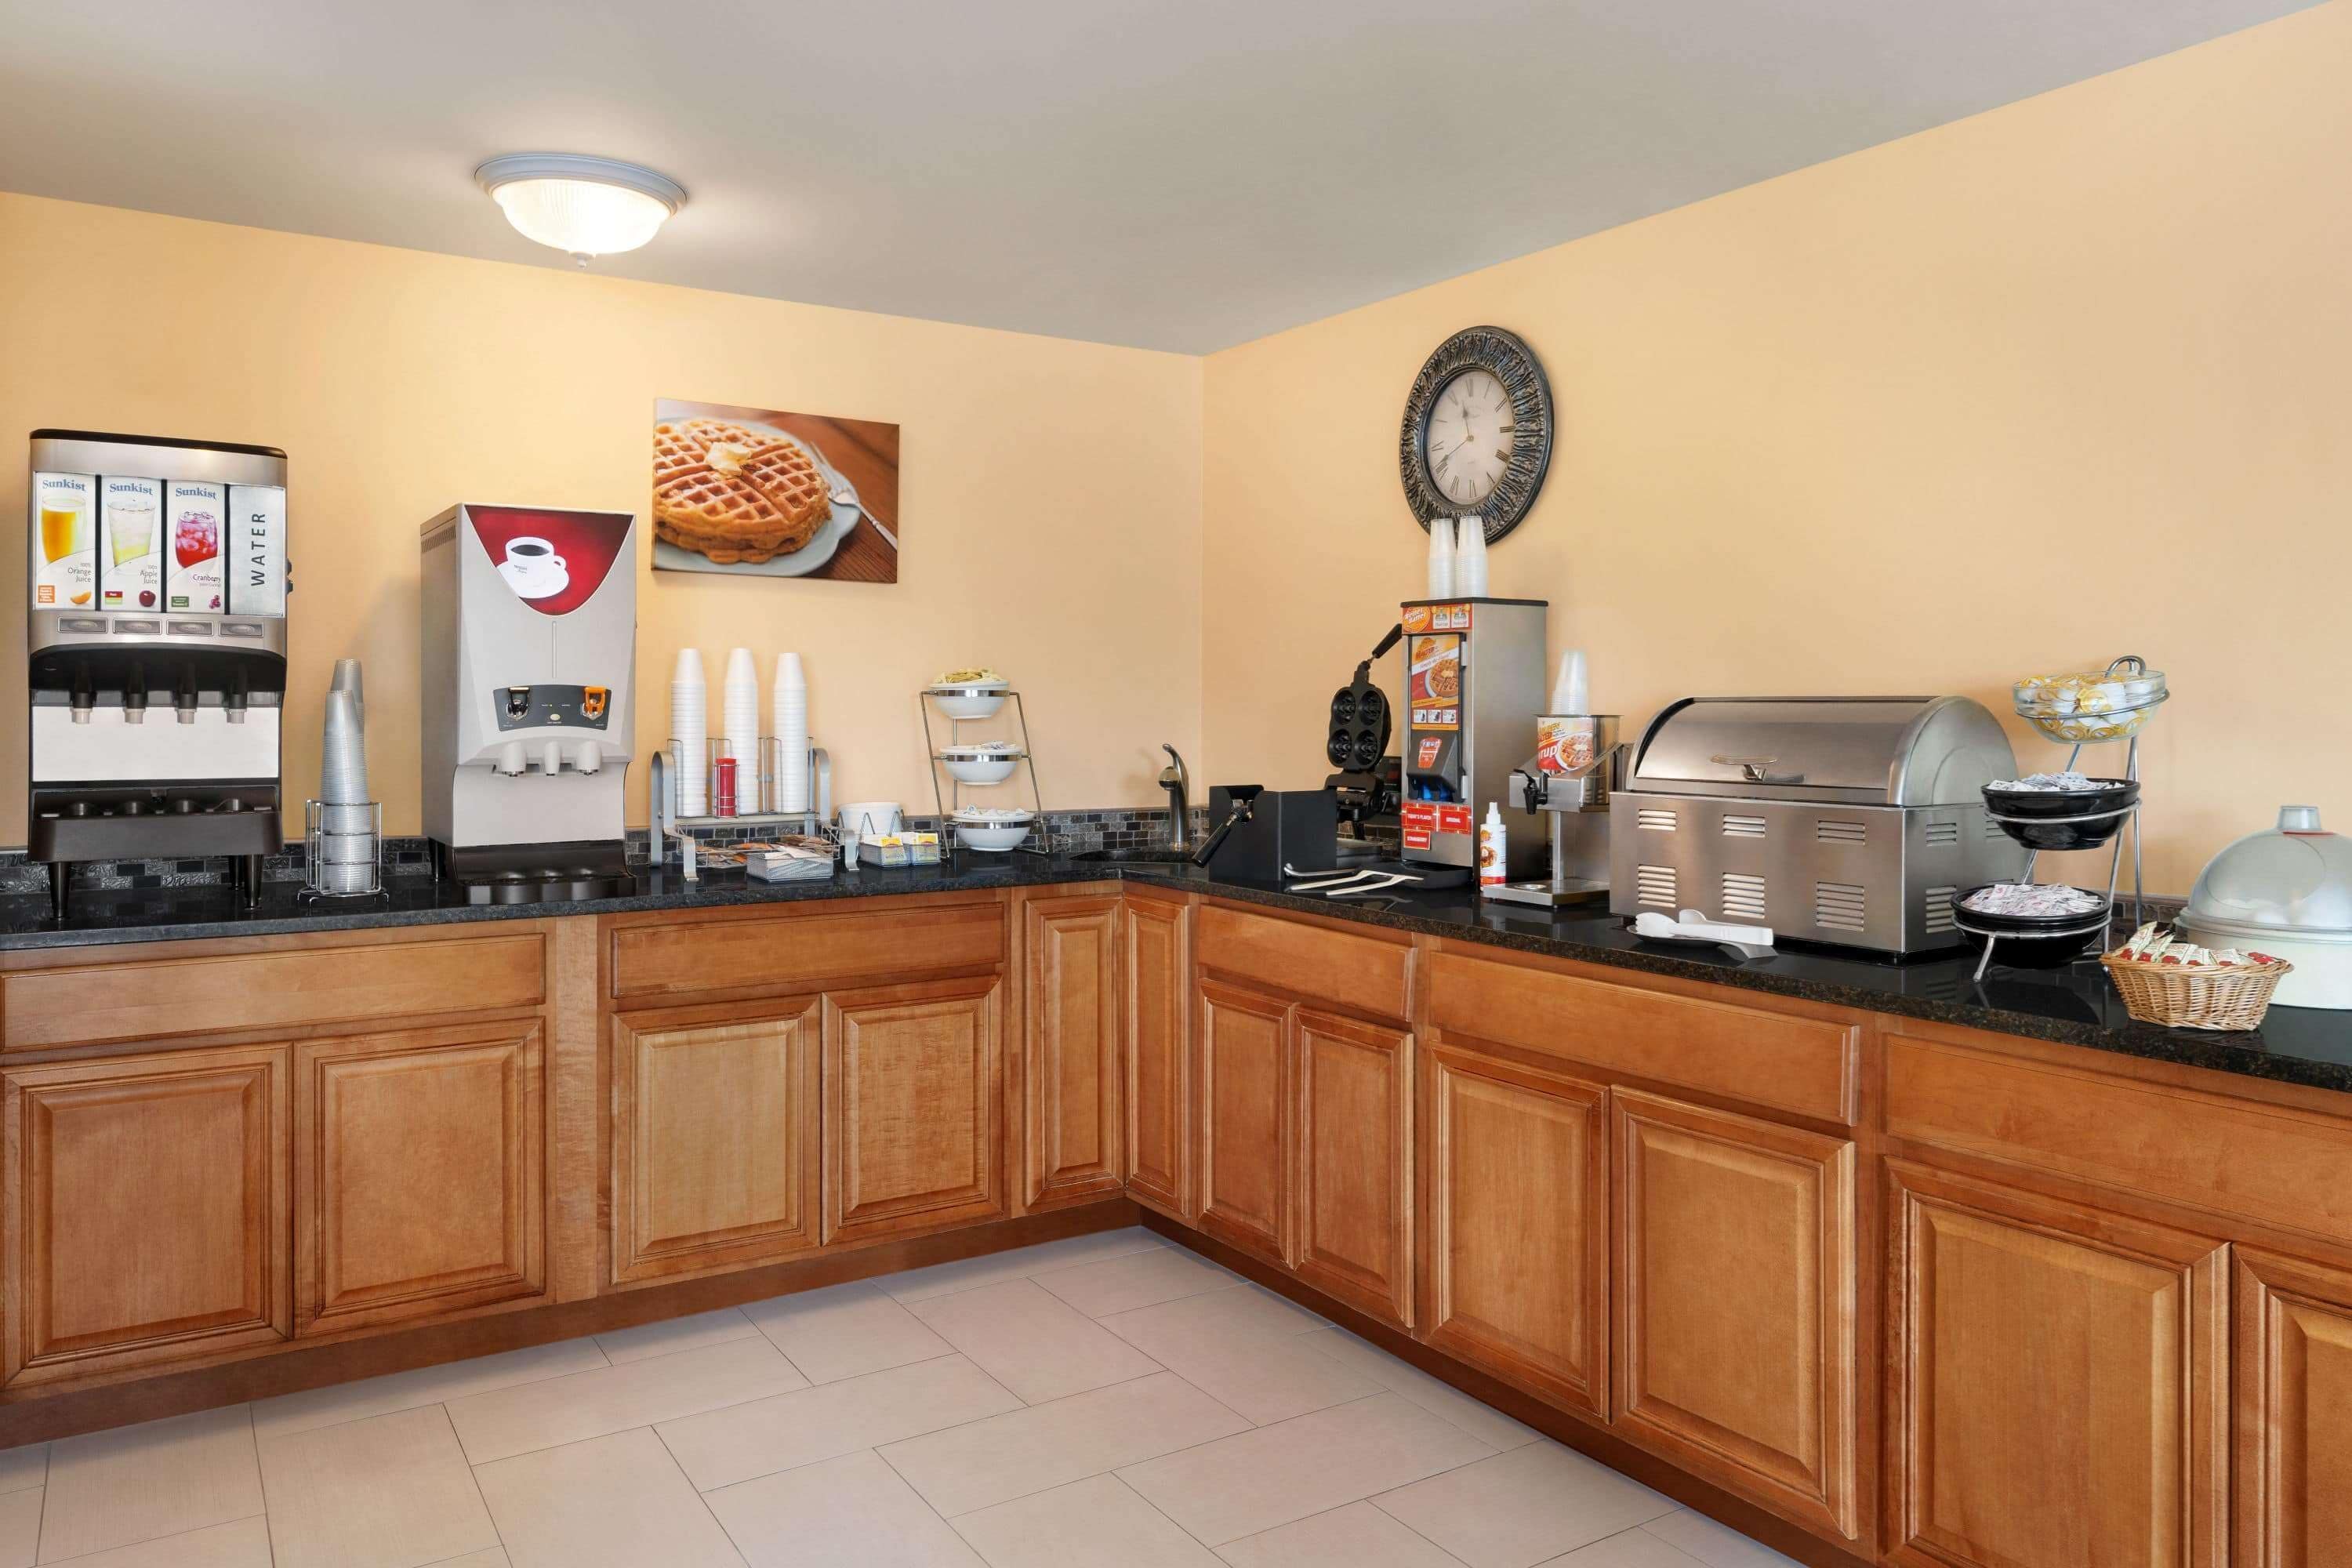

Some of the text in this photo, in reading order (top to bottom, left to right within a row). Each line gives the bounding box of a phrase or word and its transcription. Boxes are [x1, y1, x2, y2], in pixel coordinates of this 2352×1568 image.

[42, 479, 86, 491] Sunkist
[109, 483, 154, 495] Sunkist
[176, 487, 216, 500] Sunkist
[251, 514, 266, 586] WATER
[67, 567, 92, 577] Orange
[140, 570, 158, 579] Apple
[75, 575, 92, 583] Juice
[193, 574, 221, 583] Cranberry
